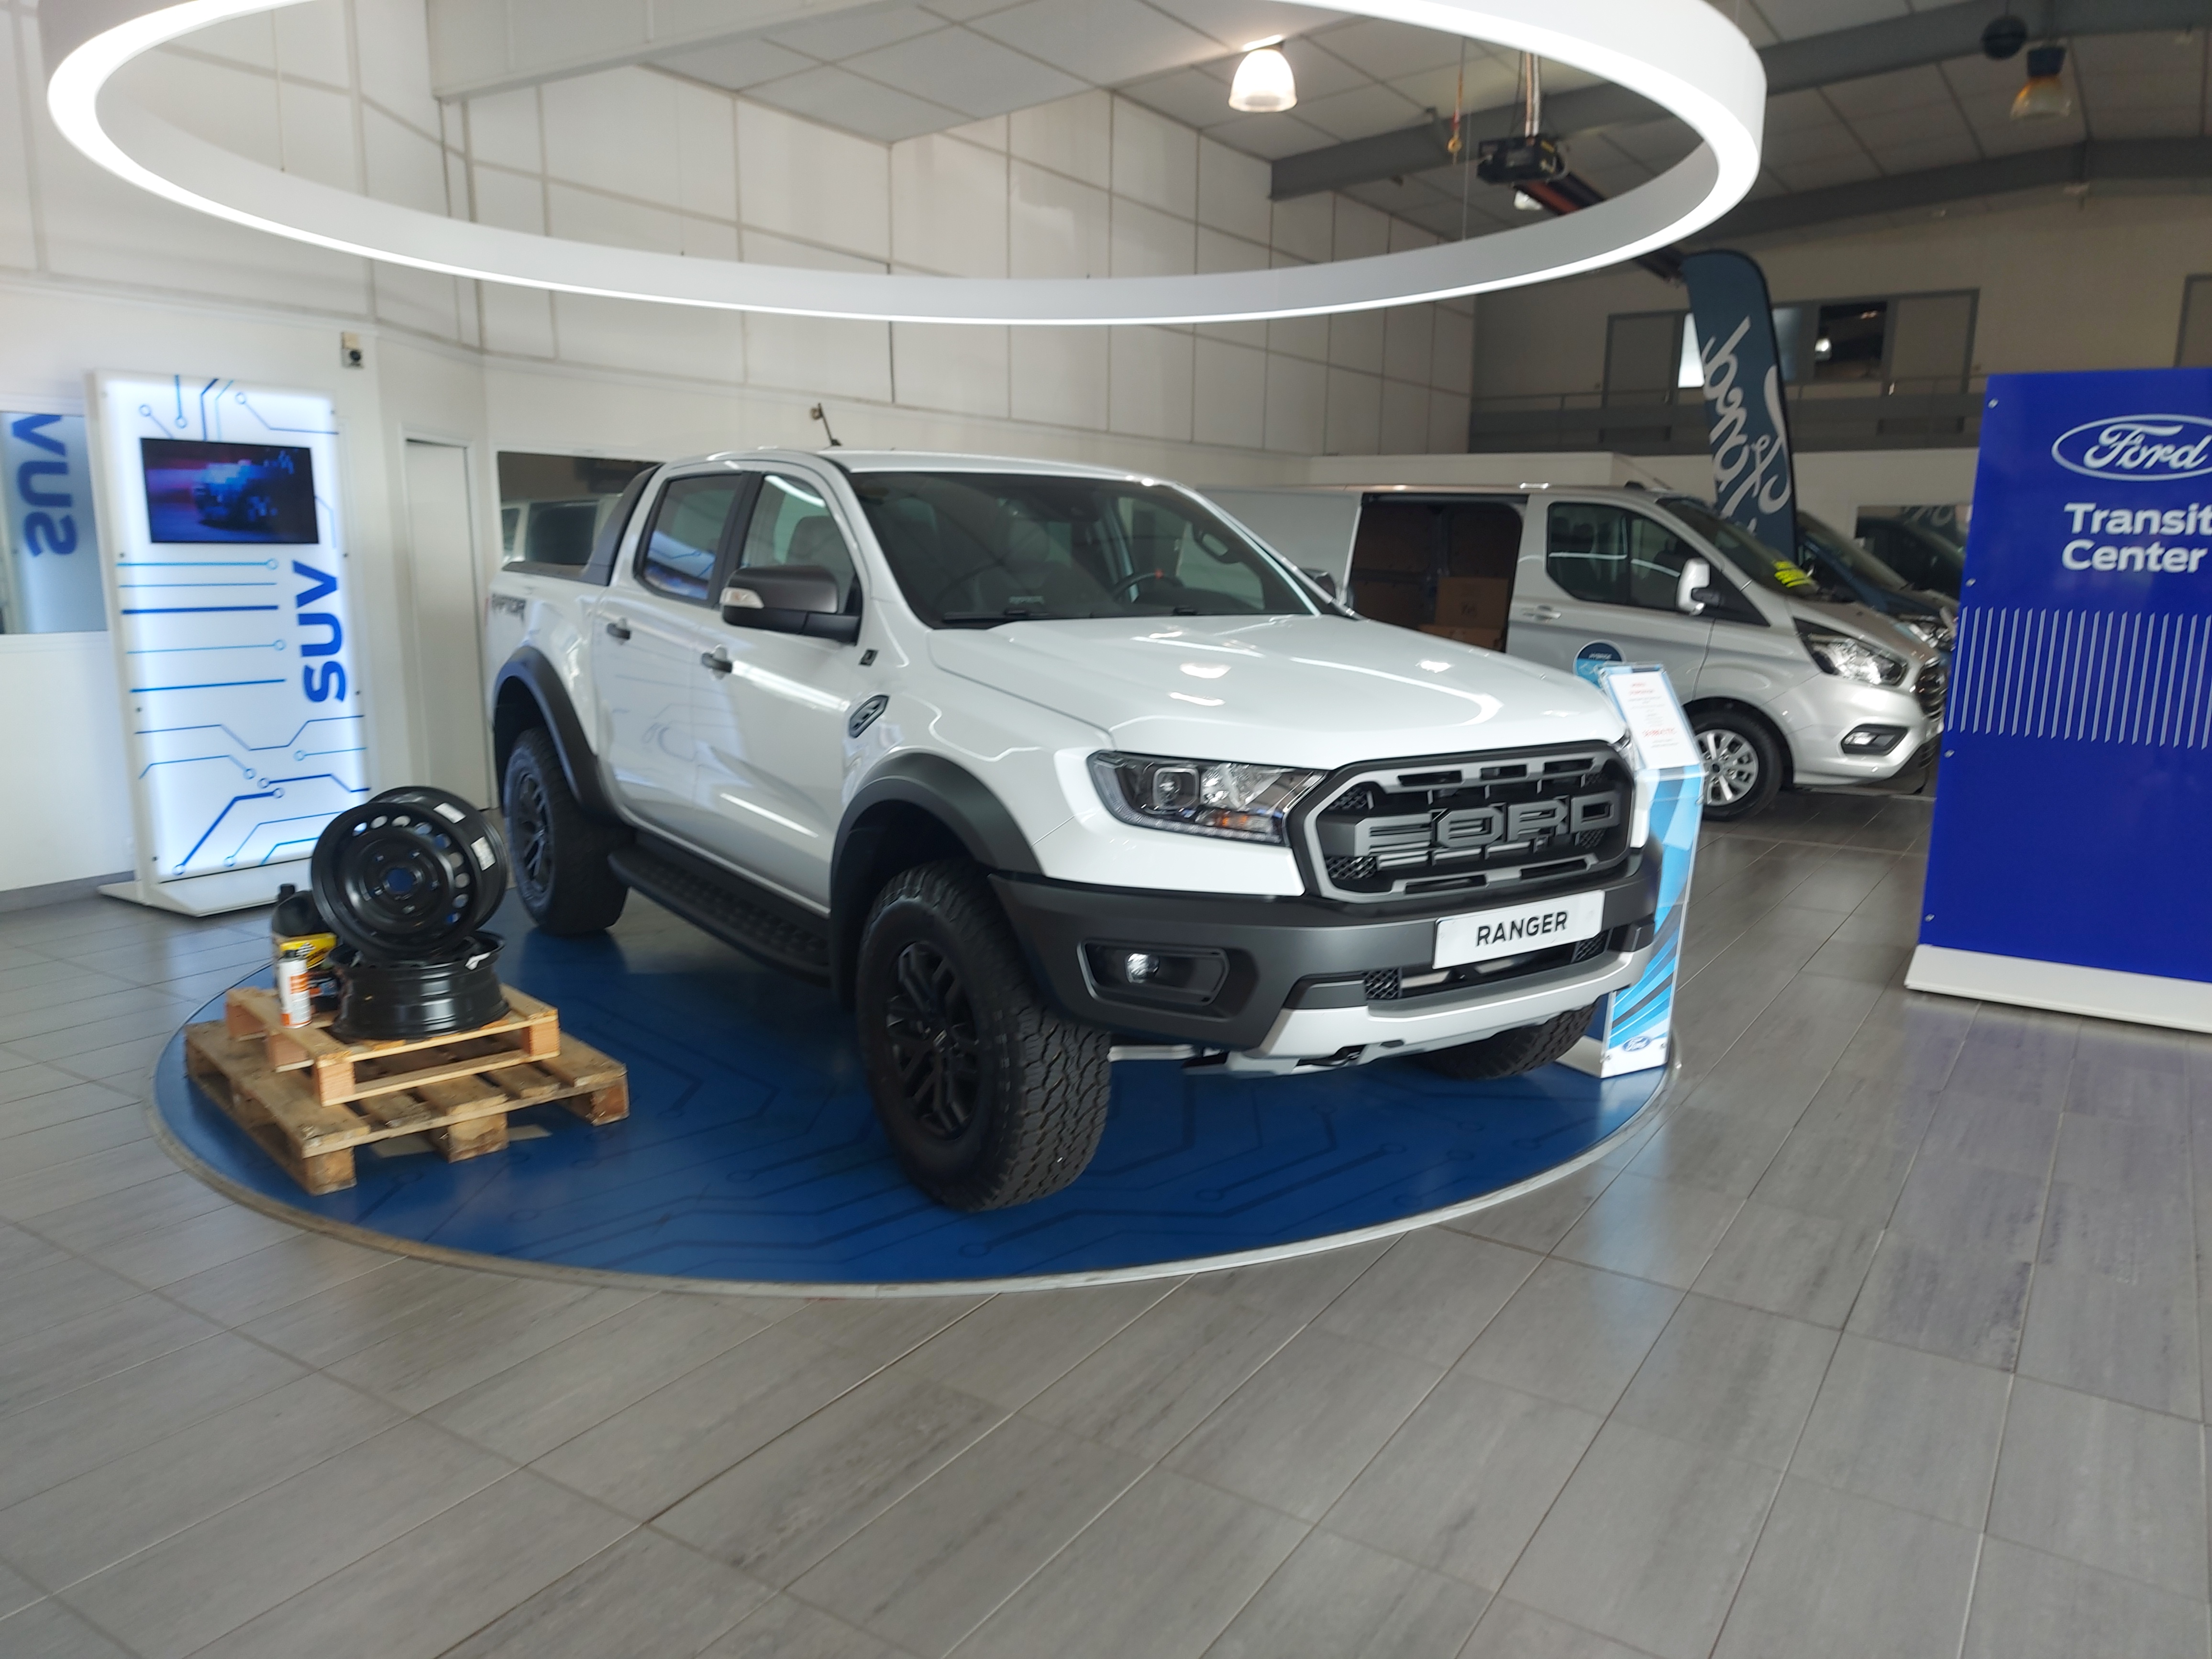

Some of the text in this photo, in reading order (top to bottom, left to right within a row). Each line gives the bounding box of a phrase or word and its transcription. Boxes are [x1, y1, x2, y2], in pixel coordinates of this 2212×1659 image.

[2083, 423, 2212, 470] Ford
[2063, 502, 2212, 536] Transit
[2061, 539, 2208, 573] Center
[292, 559, 346, 703] SUV
[1354, 790, 1621, 858] FORD
[1475, 911, 1569, 947] RANGER
